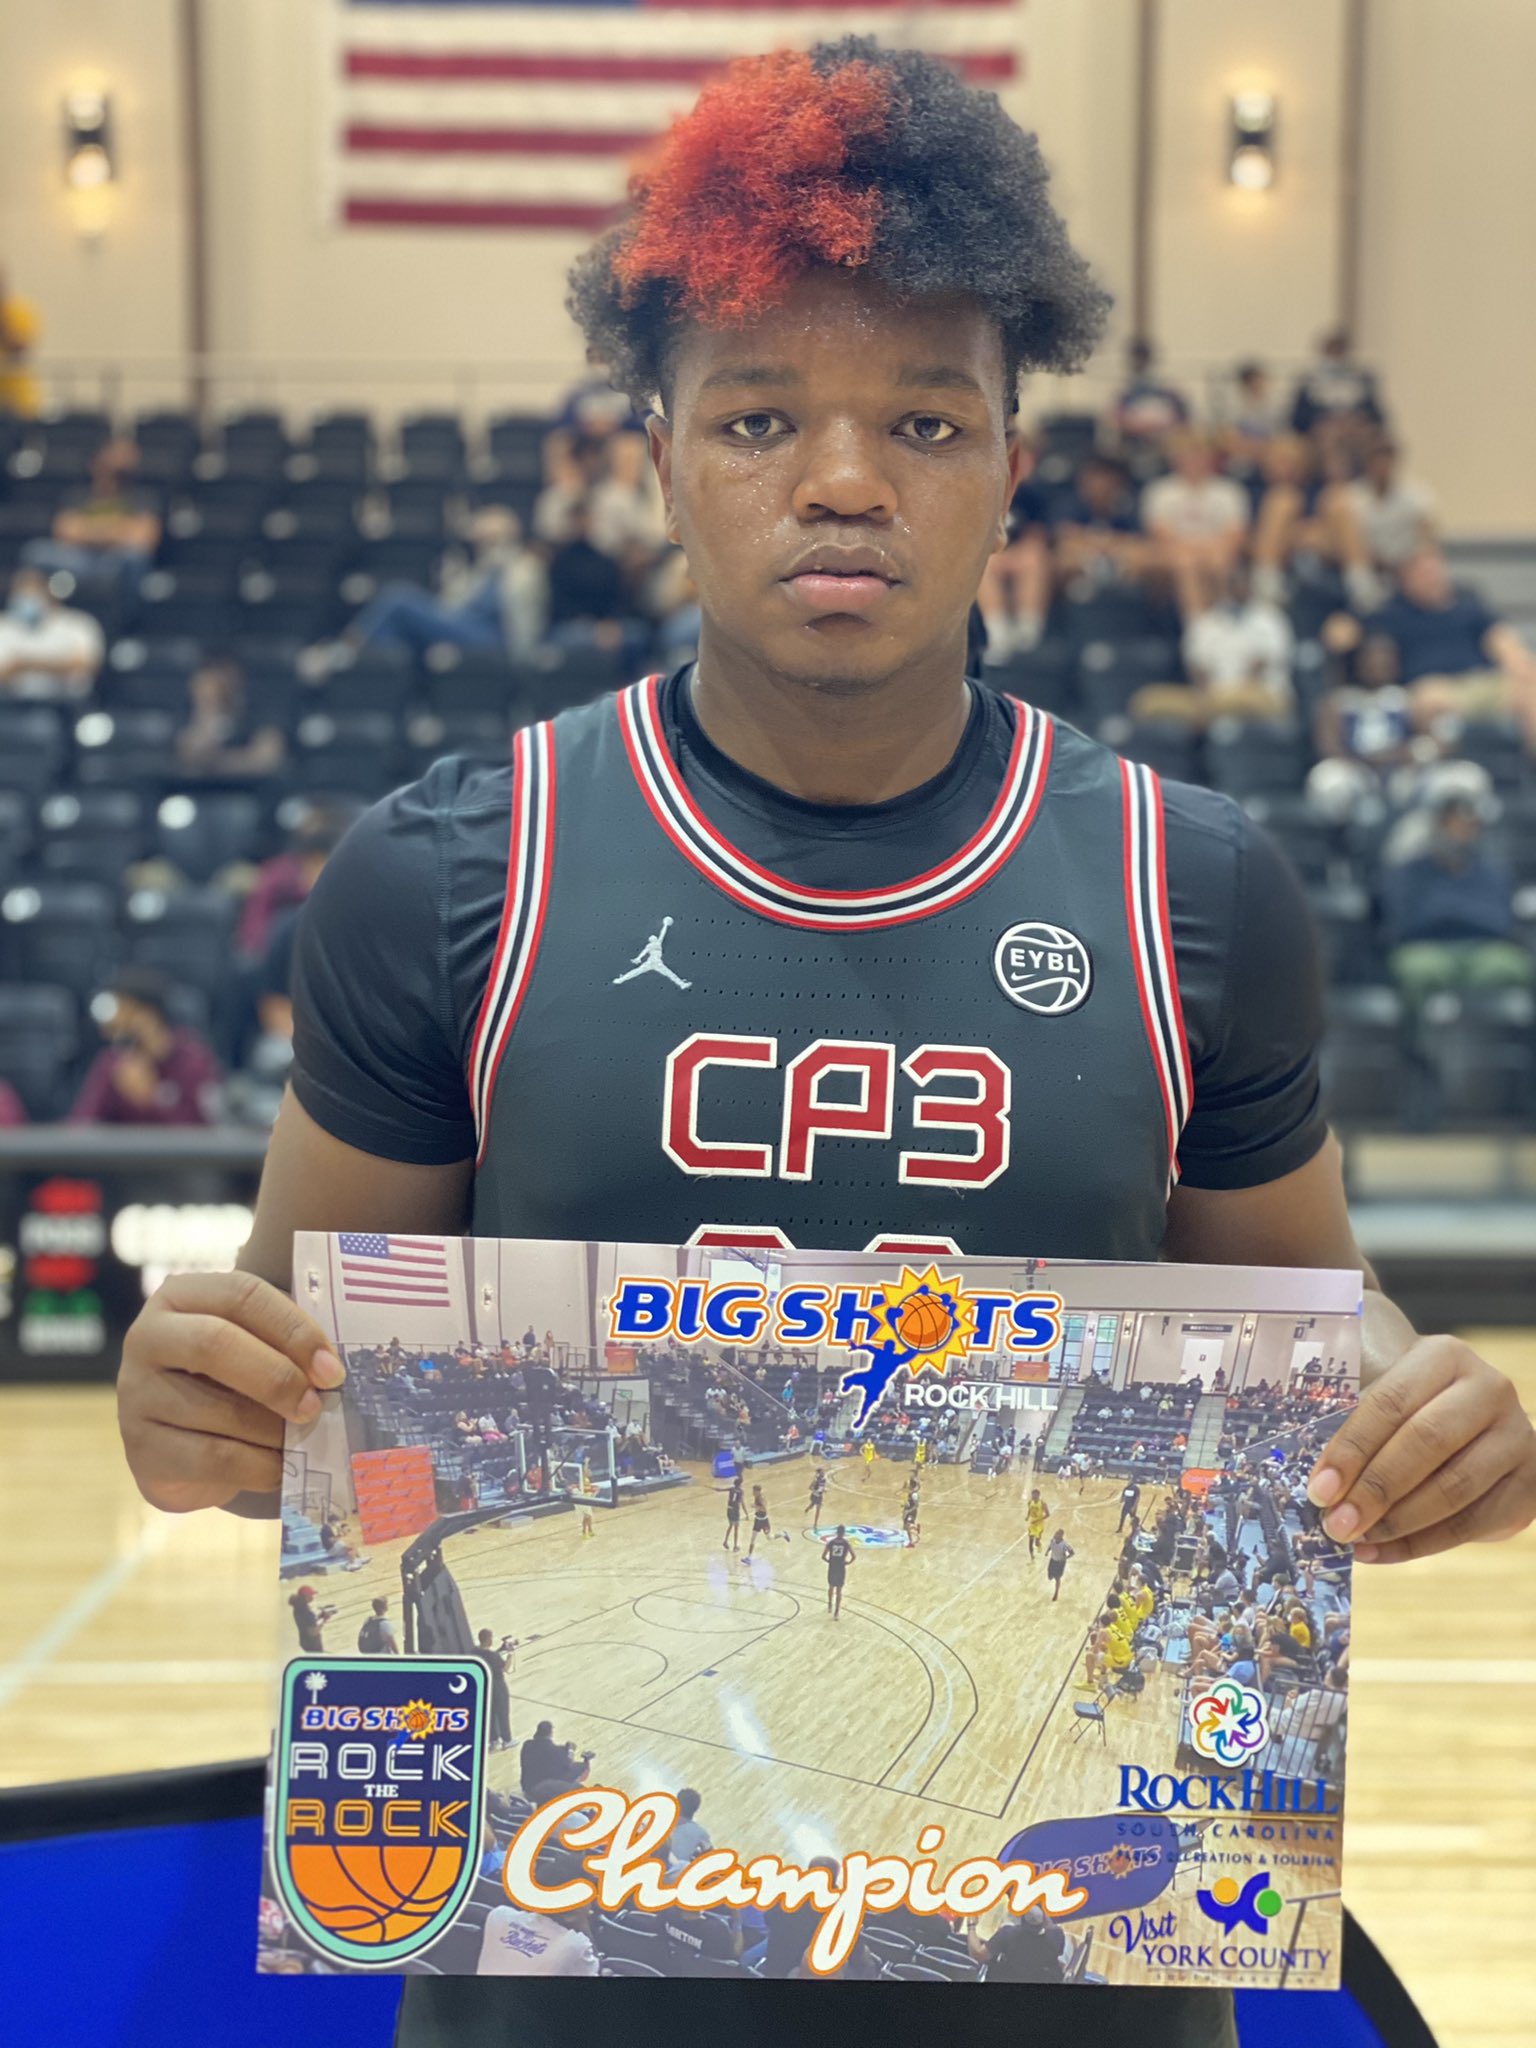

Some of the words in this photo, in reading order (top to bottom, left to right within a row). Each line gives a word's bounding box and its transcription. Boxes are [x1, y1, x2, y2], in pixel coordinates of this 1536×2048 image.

[1009, 947, 1081, 975] EYBL
[661, 1031, 1012, 1190] CP3
[611, 1277, 771, 1344] BIG
[775, 1268, 1066, 1364] SHOTS
[904, 1382, 989, 1409] ROCK
[996, 1386, 1058, 1411] HILL
[302, 1705, 360, 1730] BIG
[361, 1701, 470, 1738] SHOTS
[289, 1742, 472, 1781] ROCK
[364, 1783, 399, 1799] THE
[1118, 1763, 1237, 1813] ROCK
[1240, 1768, 1340, 1815] HILL
[286, 1798, 469, 1838] ROCK
[1212, 1823, 1336, 1843] CAROLINA
[502, 1787, 1089, 1975] Champion
[1108, 1909, 1177, 1954] Visit
[1142, 1944, 1213, 1968] YORK
[1219, 1946, 1331, 1971] COUNTY
